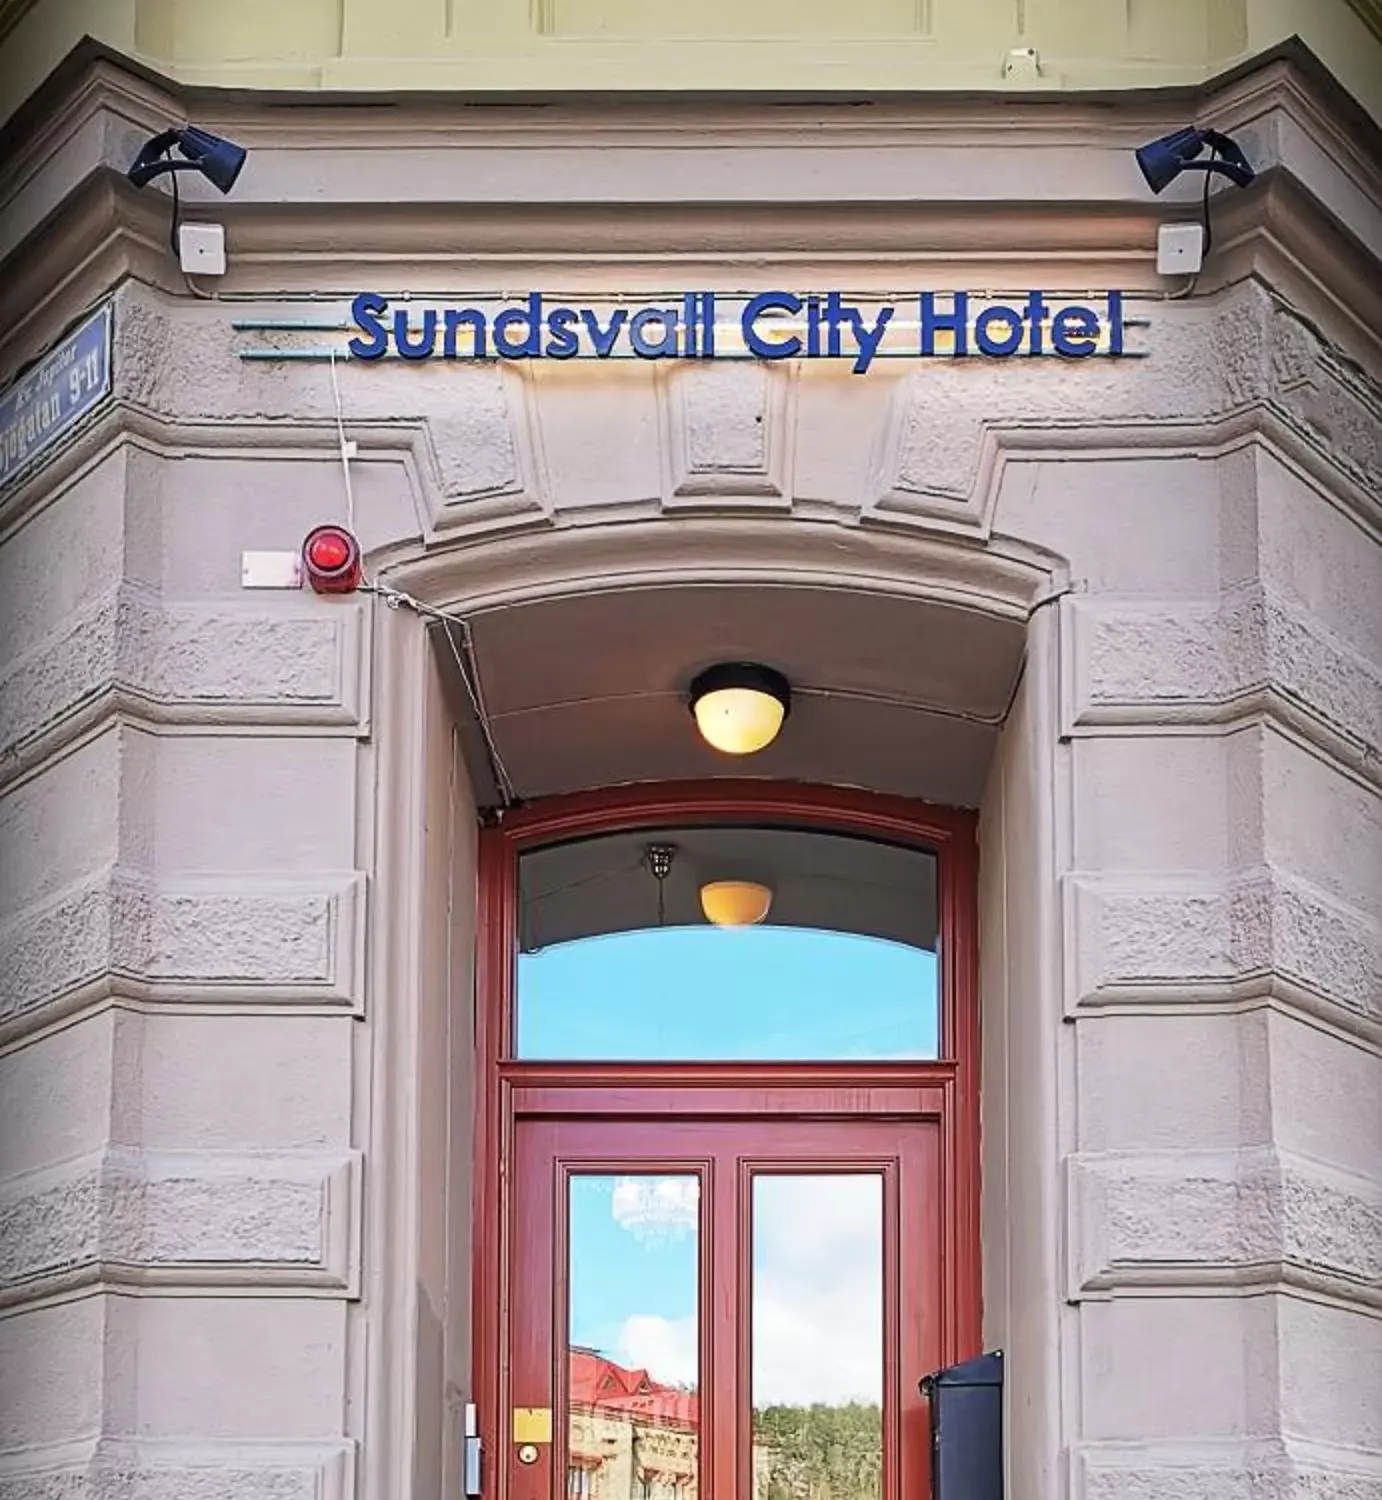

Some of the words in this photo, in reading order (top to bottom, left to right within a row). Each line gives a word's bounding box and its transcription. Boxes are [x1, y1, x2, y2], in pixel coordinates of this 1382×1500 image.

[348, 291, 716, 360] Sundsvall
[741, 291, 894, 374] City
[920, 290, 1123, 358] Hotel
[0, 391, 62, 472] jögatan
[68, 347, 99, 402] 9-11
